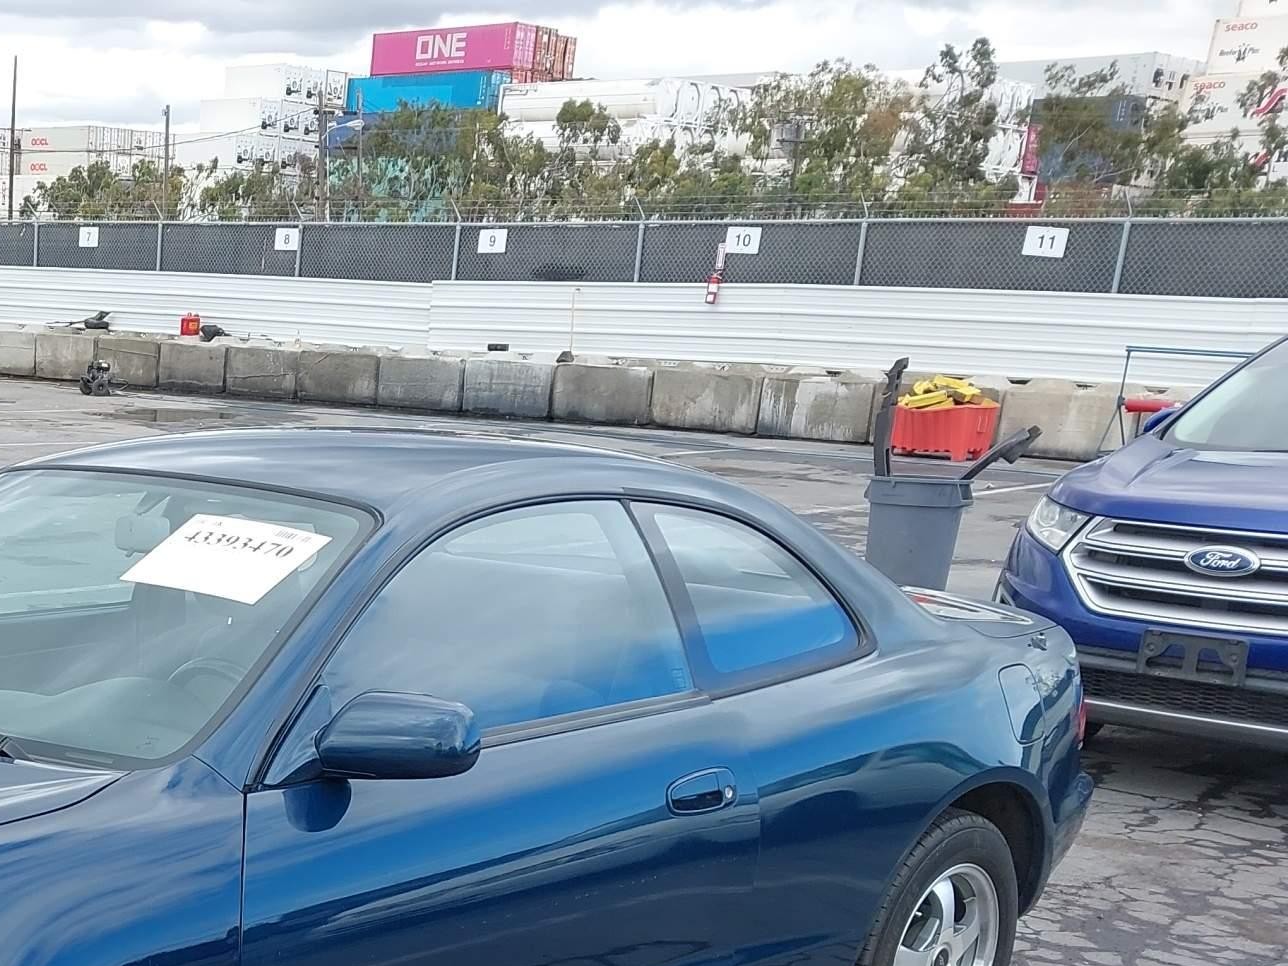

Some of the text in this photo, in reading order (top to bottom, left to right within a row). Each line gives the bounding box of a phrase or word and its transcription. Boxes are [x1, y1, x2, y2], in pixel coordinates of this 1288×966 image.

[1224, 22, 1258, 32] seaco
[415, 32, 467, 60] ONE
[31, 138, 49, 146] OOCL
[30, 163, 48, 171] OOCL
[87, 231, 92, 242] 7
[284, 233, 290, 245] 8
[489, 234, 496, 247] 9
[734, 233, 752, 247] 10
[1037, 234, 1056, 250] 11
[184, 530, 294, 557] 43393470
[1199, 551, 1242, 569] Ford
